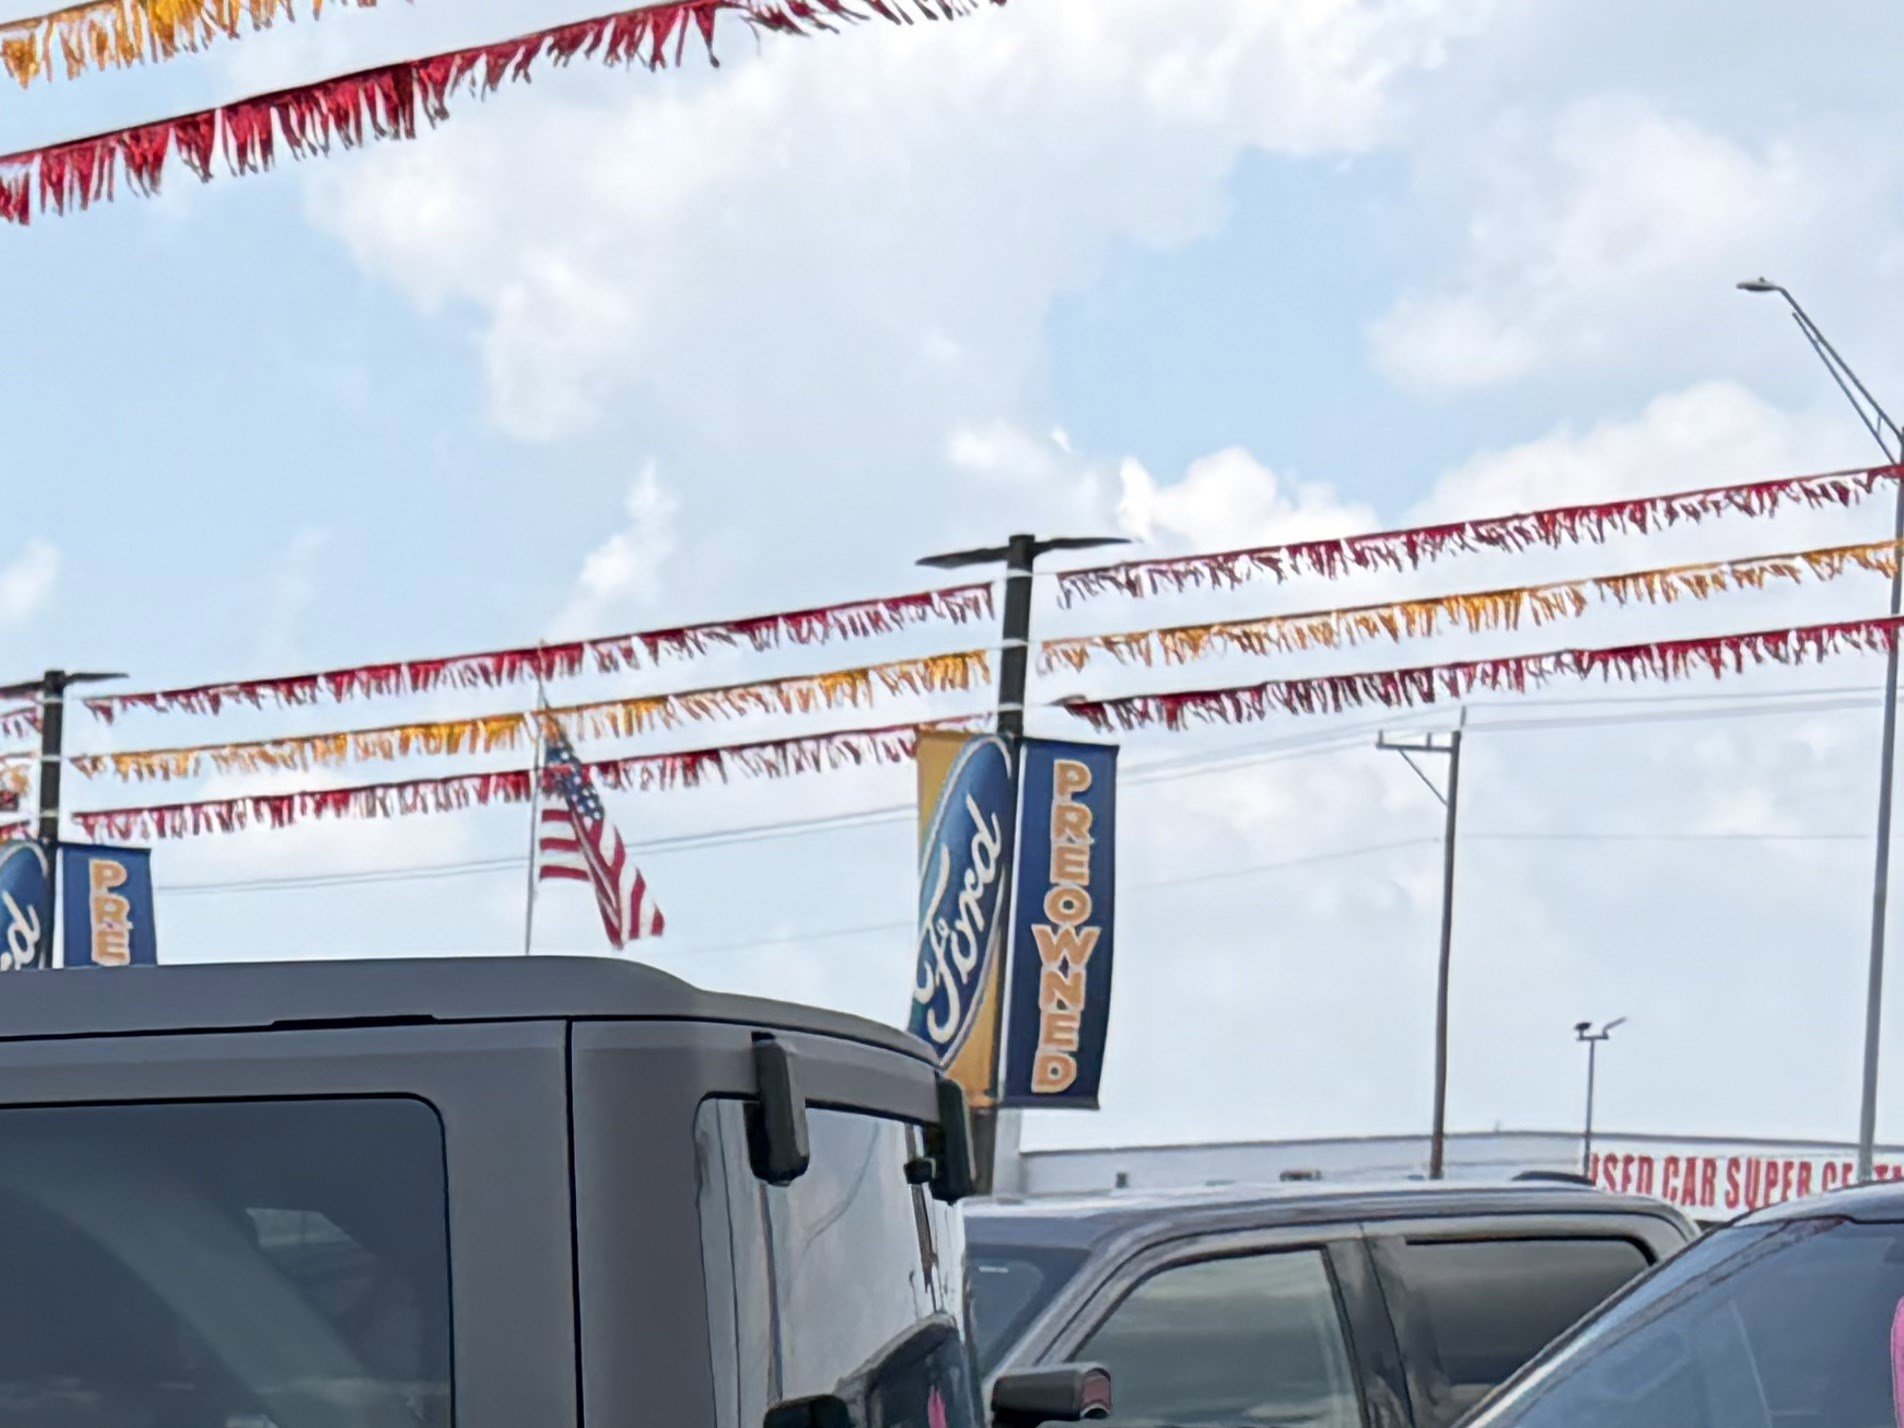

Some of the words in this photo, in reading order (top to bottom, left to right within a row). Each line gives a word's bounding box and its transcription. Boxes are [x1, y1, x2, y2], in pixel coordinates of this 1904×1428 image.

[913, 794, 1003, 1044] Ford
[1031, 757, 1101, 1093] PREOWNED
[1662, 1155, 1717, 1208] CAR
[1724, 1156, 1812, 1211] SUPER
